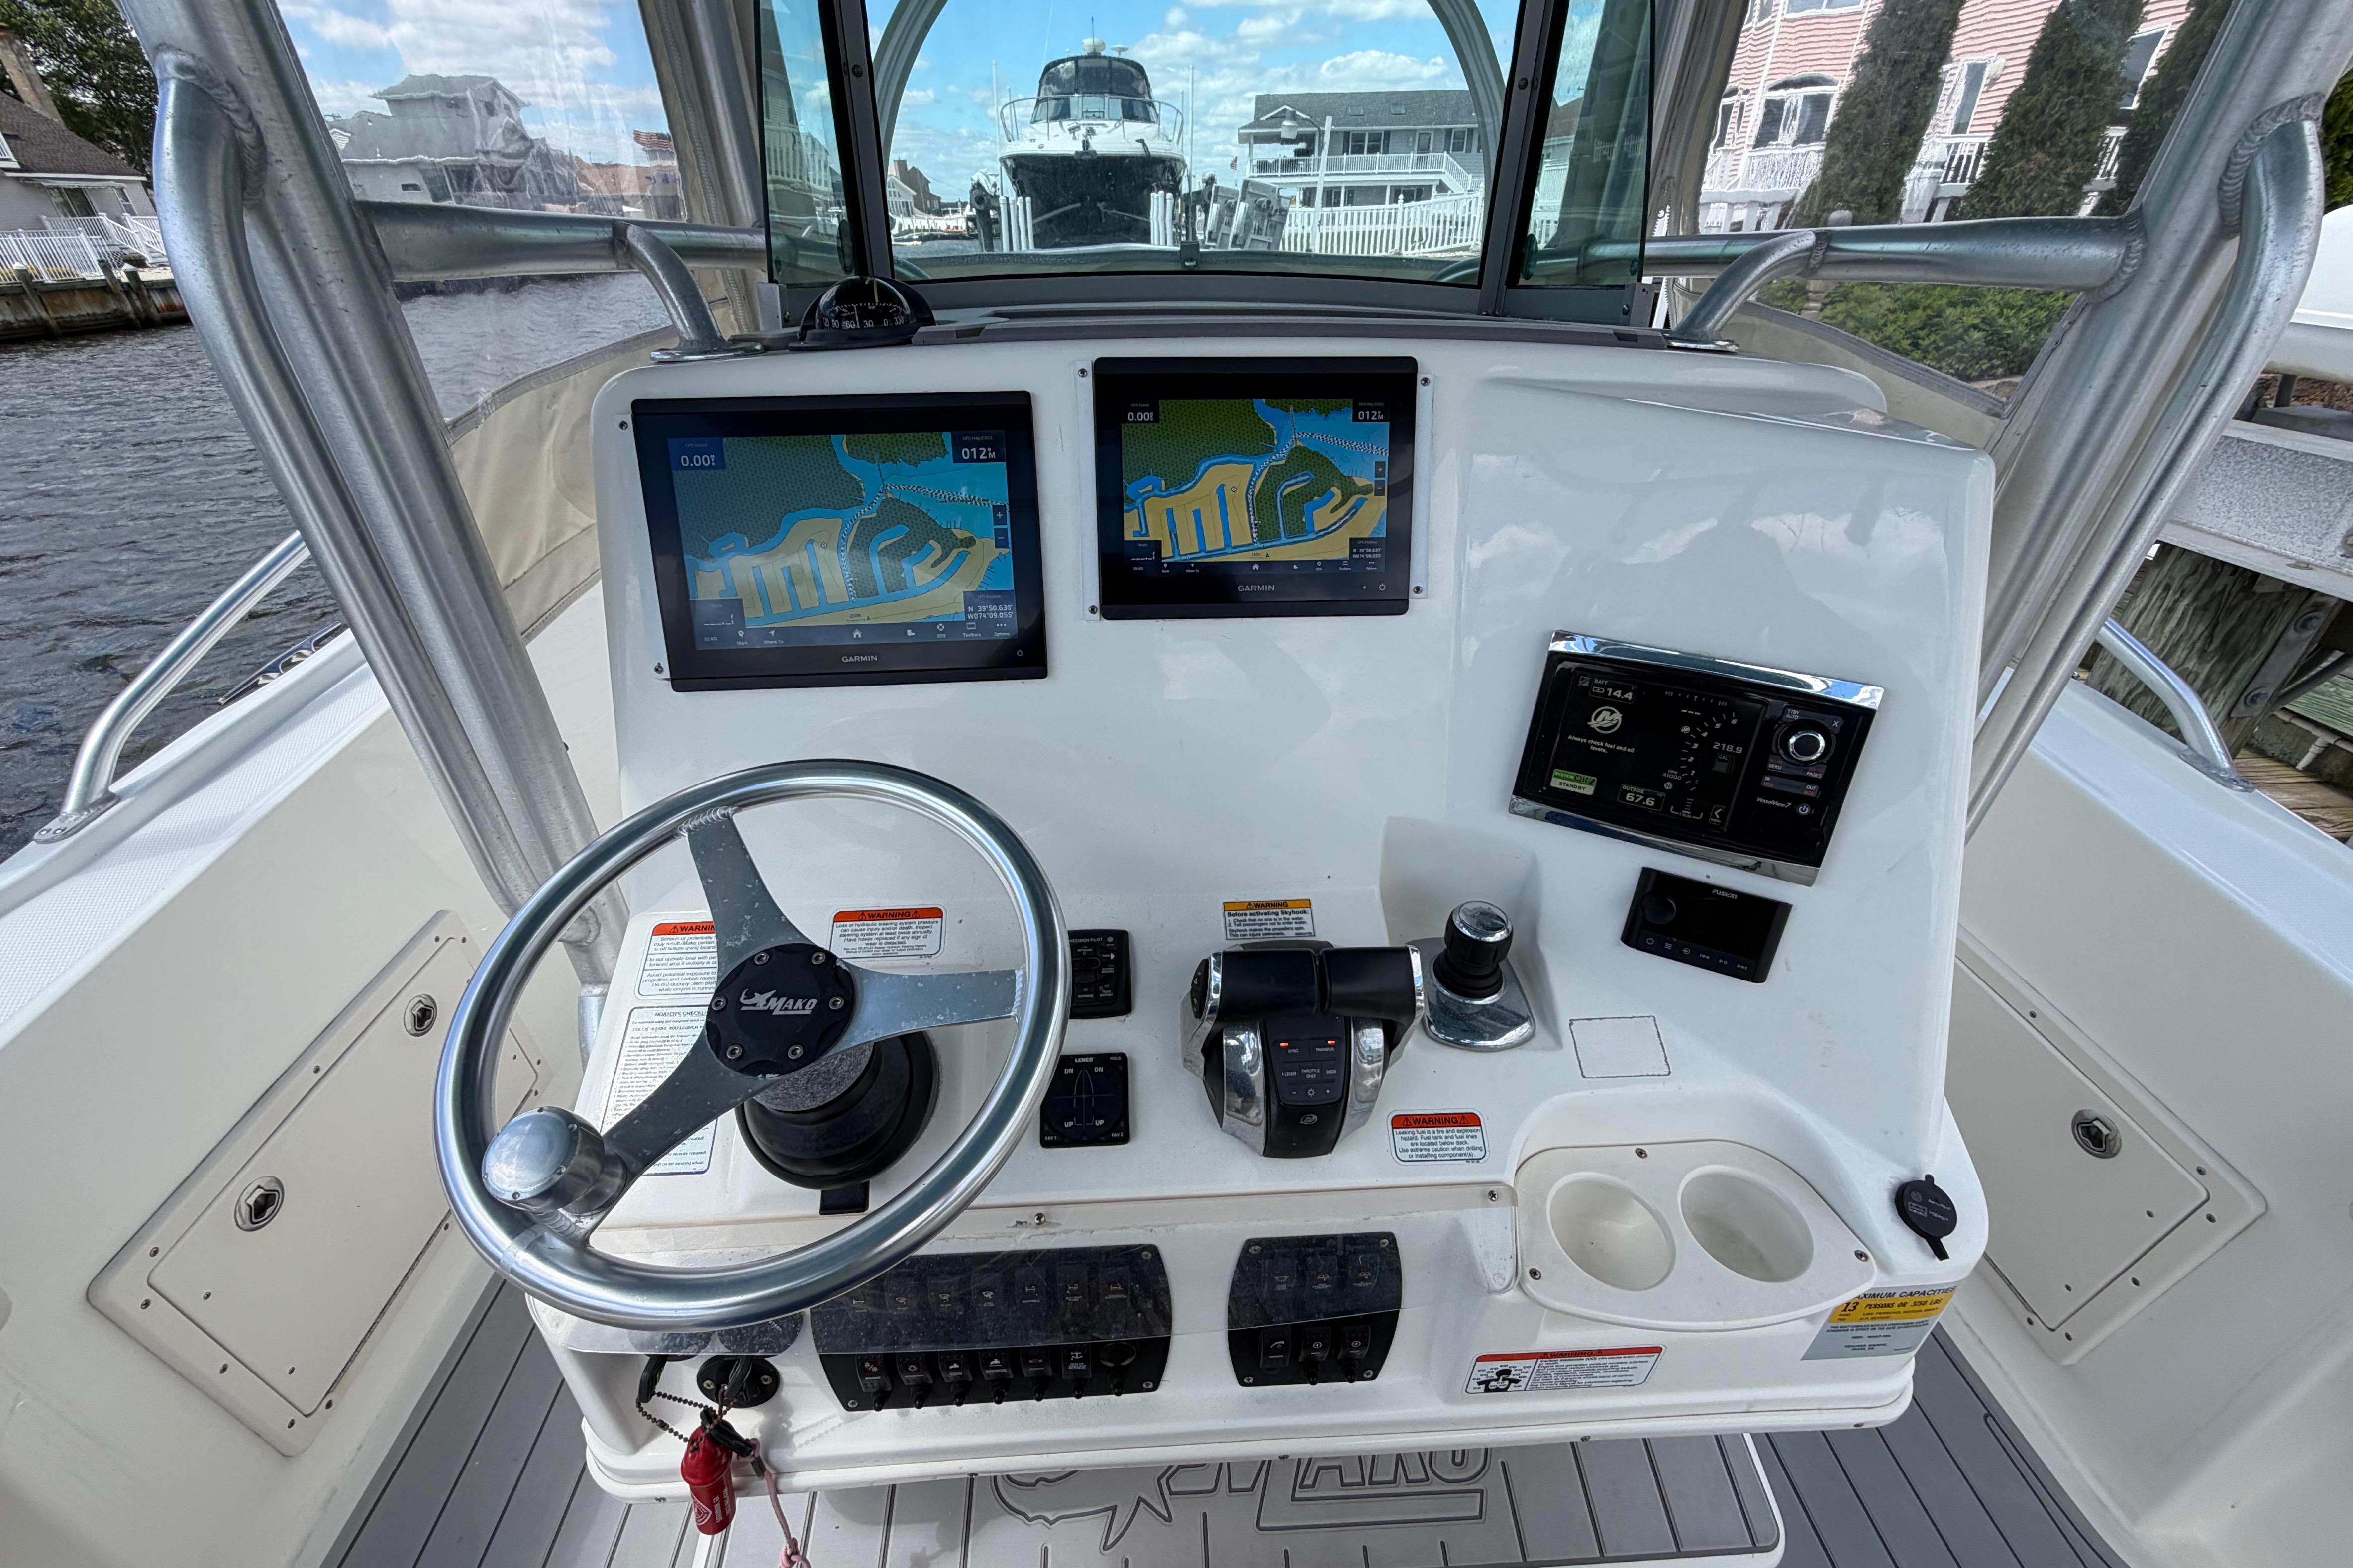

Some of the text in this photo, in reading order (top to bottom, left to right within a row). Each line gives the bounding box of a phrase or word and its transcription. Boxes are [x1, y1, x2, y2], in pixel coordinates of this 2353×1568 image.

[831, 319, 839, 328] 90
[846, 320, 855, 329] 60
[863, 320, 874, 328] 30
[1128, 412, 1150, 421] 0.00
[681, 455, 710, 466] 0.00
[1607, 688, 1633, 700] 14.4
[1568, 735, 1587, 743] Always
[1713, 742, 1743, 754] 218.9
[1559, 782, 1586, 790] STANDBY
[1622, 785, 1645, 794] OUTSIDE
[1626, 793, 1655, 806] 67.6
[766, 997, 818, 1015] MAKO
[1899, 1286, 1956, 1297] CAPACITIES
[1841, 1302, 1860, 1312] 13
